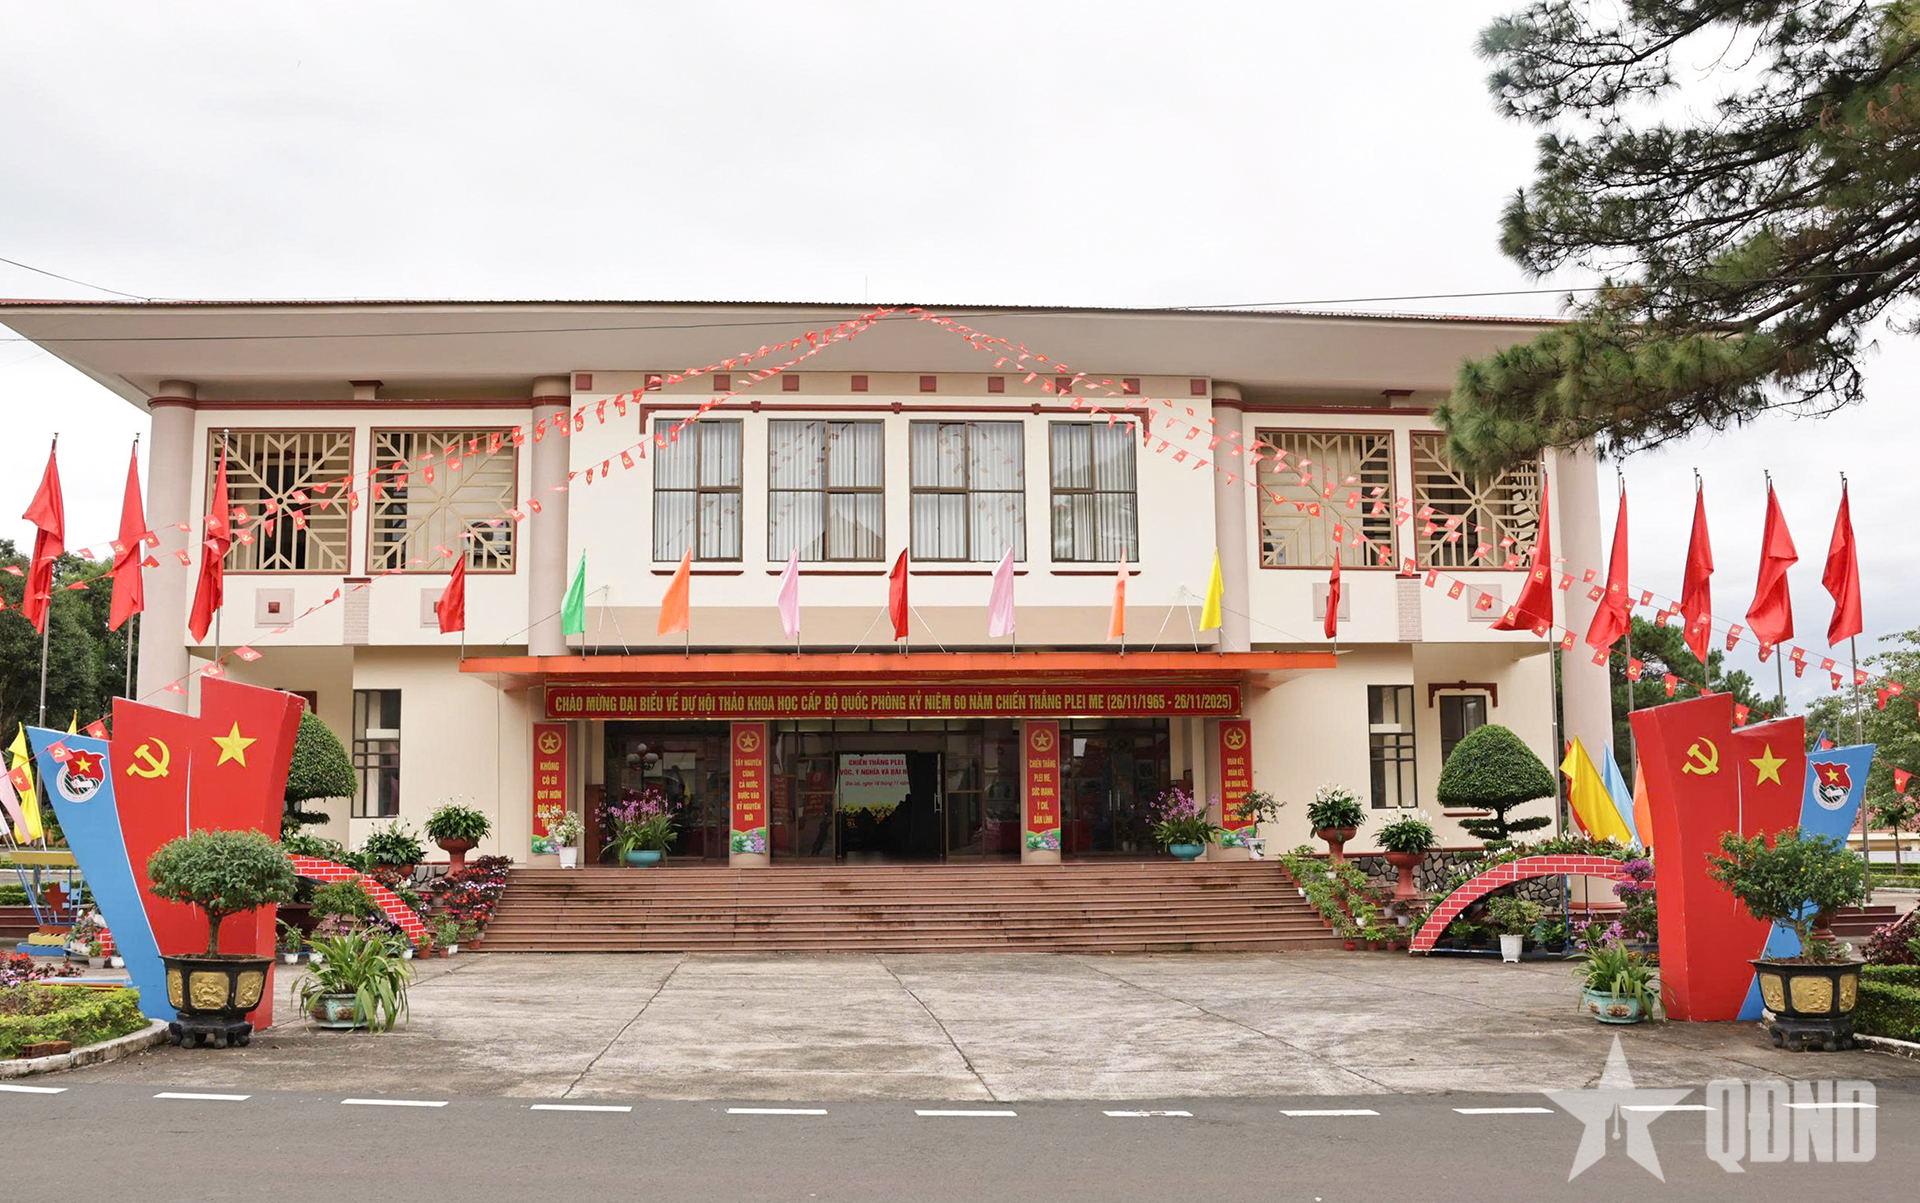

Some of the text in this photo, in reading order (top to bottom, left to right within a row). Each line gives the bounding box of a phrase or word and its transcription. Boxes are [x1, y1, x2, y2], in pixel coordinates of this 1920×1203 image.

[555, 693, 583, 712] CHÀO
[586, 693, 617, 712] MỪNG
[619, 696, 637, 714] ĐẠI
[640, 690, 664, 712] BIỂU
[681, 695, 697, 714] DỰ
[698, 693, 716, 714] HỘI
[718, 691, 745, 712] THẢO
[747, 696, 775, 711] KHOA
[777, 696, 798, 714] HỌC
[801, 690, 822, 711] CẤP
[824, 692, 839, 714] BỘ
[841, 690, 869, 712] QUỐC
[871, 691, 906, 711] PHÒNG
[909, 690, 922, 711] KỶ
[924, 692, 951, 713] NIỆM
[953, 695, 967, 711] 60
[969, 691, 993, 710] NĂM
[995, 689, 1026, 710] CHIẾN
[1029, 689, 1062, 709] THẮNG
[1064, 695, 1086, 709] PLEI
[1089, 694, 1104, 709] ME
[1107, 694, 1165, 710] (26/11/1965
[1174, 694, 1232, 710] 26/11/2025)
